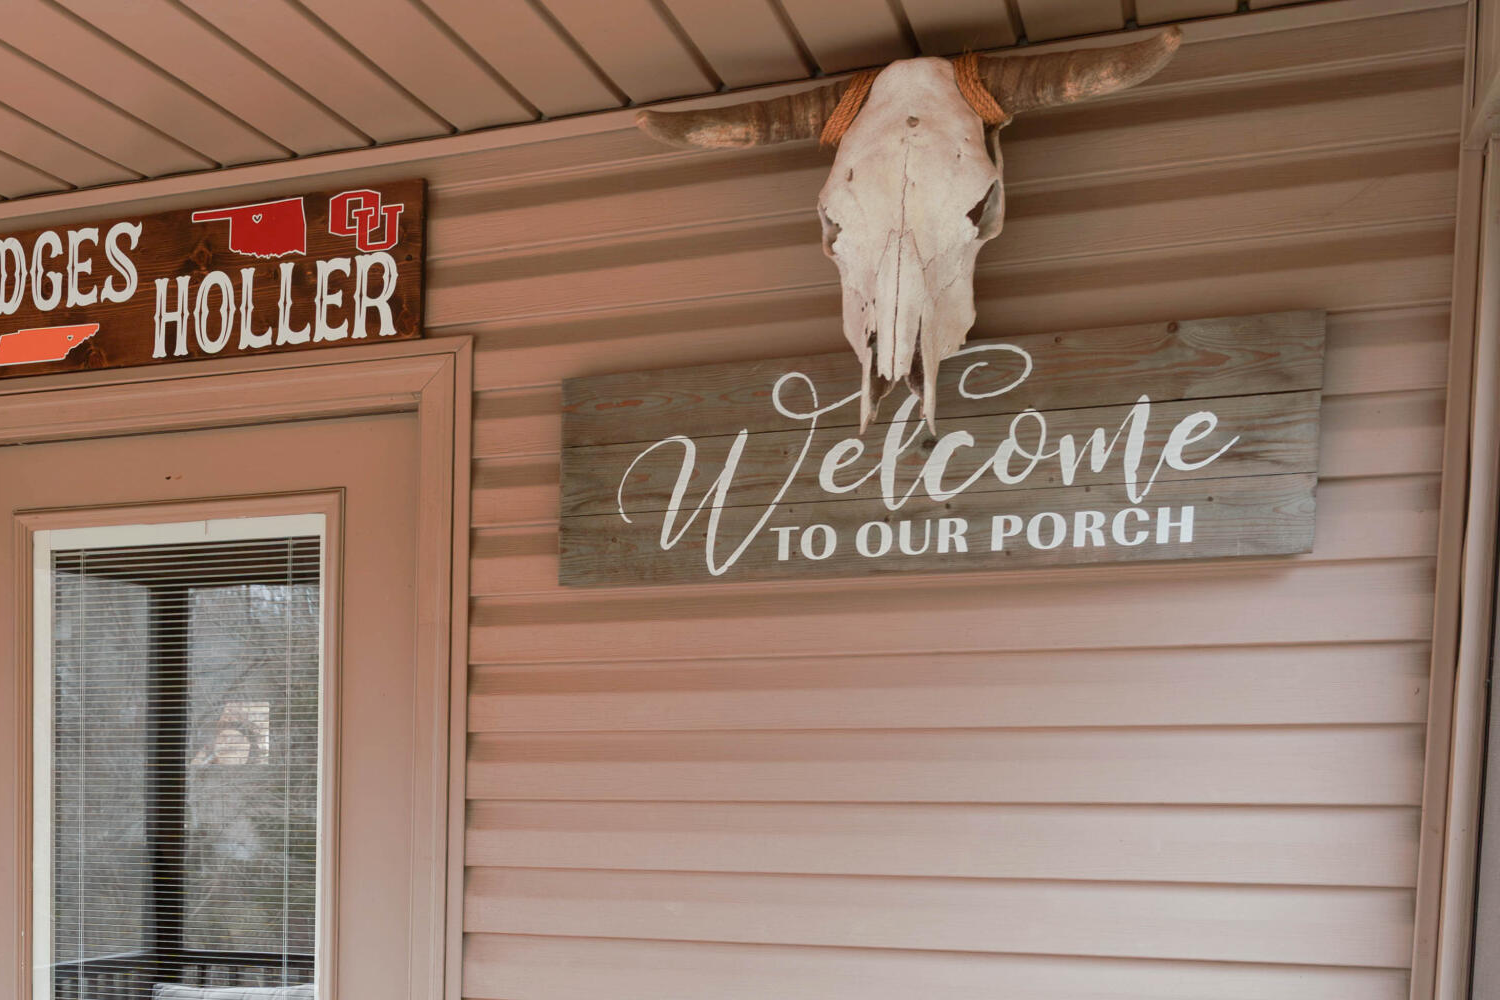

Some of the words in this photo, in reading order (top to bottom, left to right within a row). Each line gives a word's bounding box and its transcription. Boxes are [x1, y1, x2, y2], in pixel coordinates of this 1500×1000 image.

[328, 189, 404, 252] OU
[151, 252, 398, 358] HOLLER
[617, 344, 1240, 575] Welcome
[769, 523, 837, 561] TO
[855, 517, 968, 558] OUR
[990, 505, 1195, 552] PORCH
